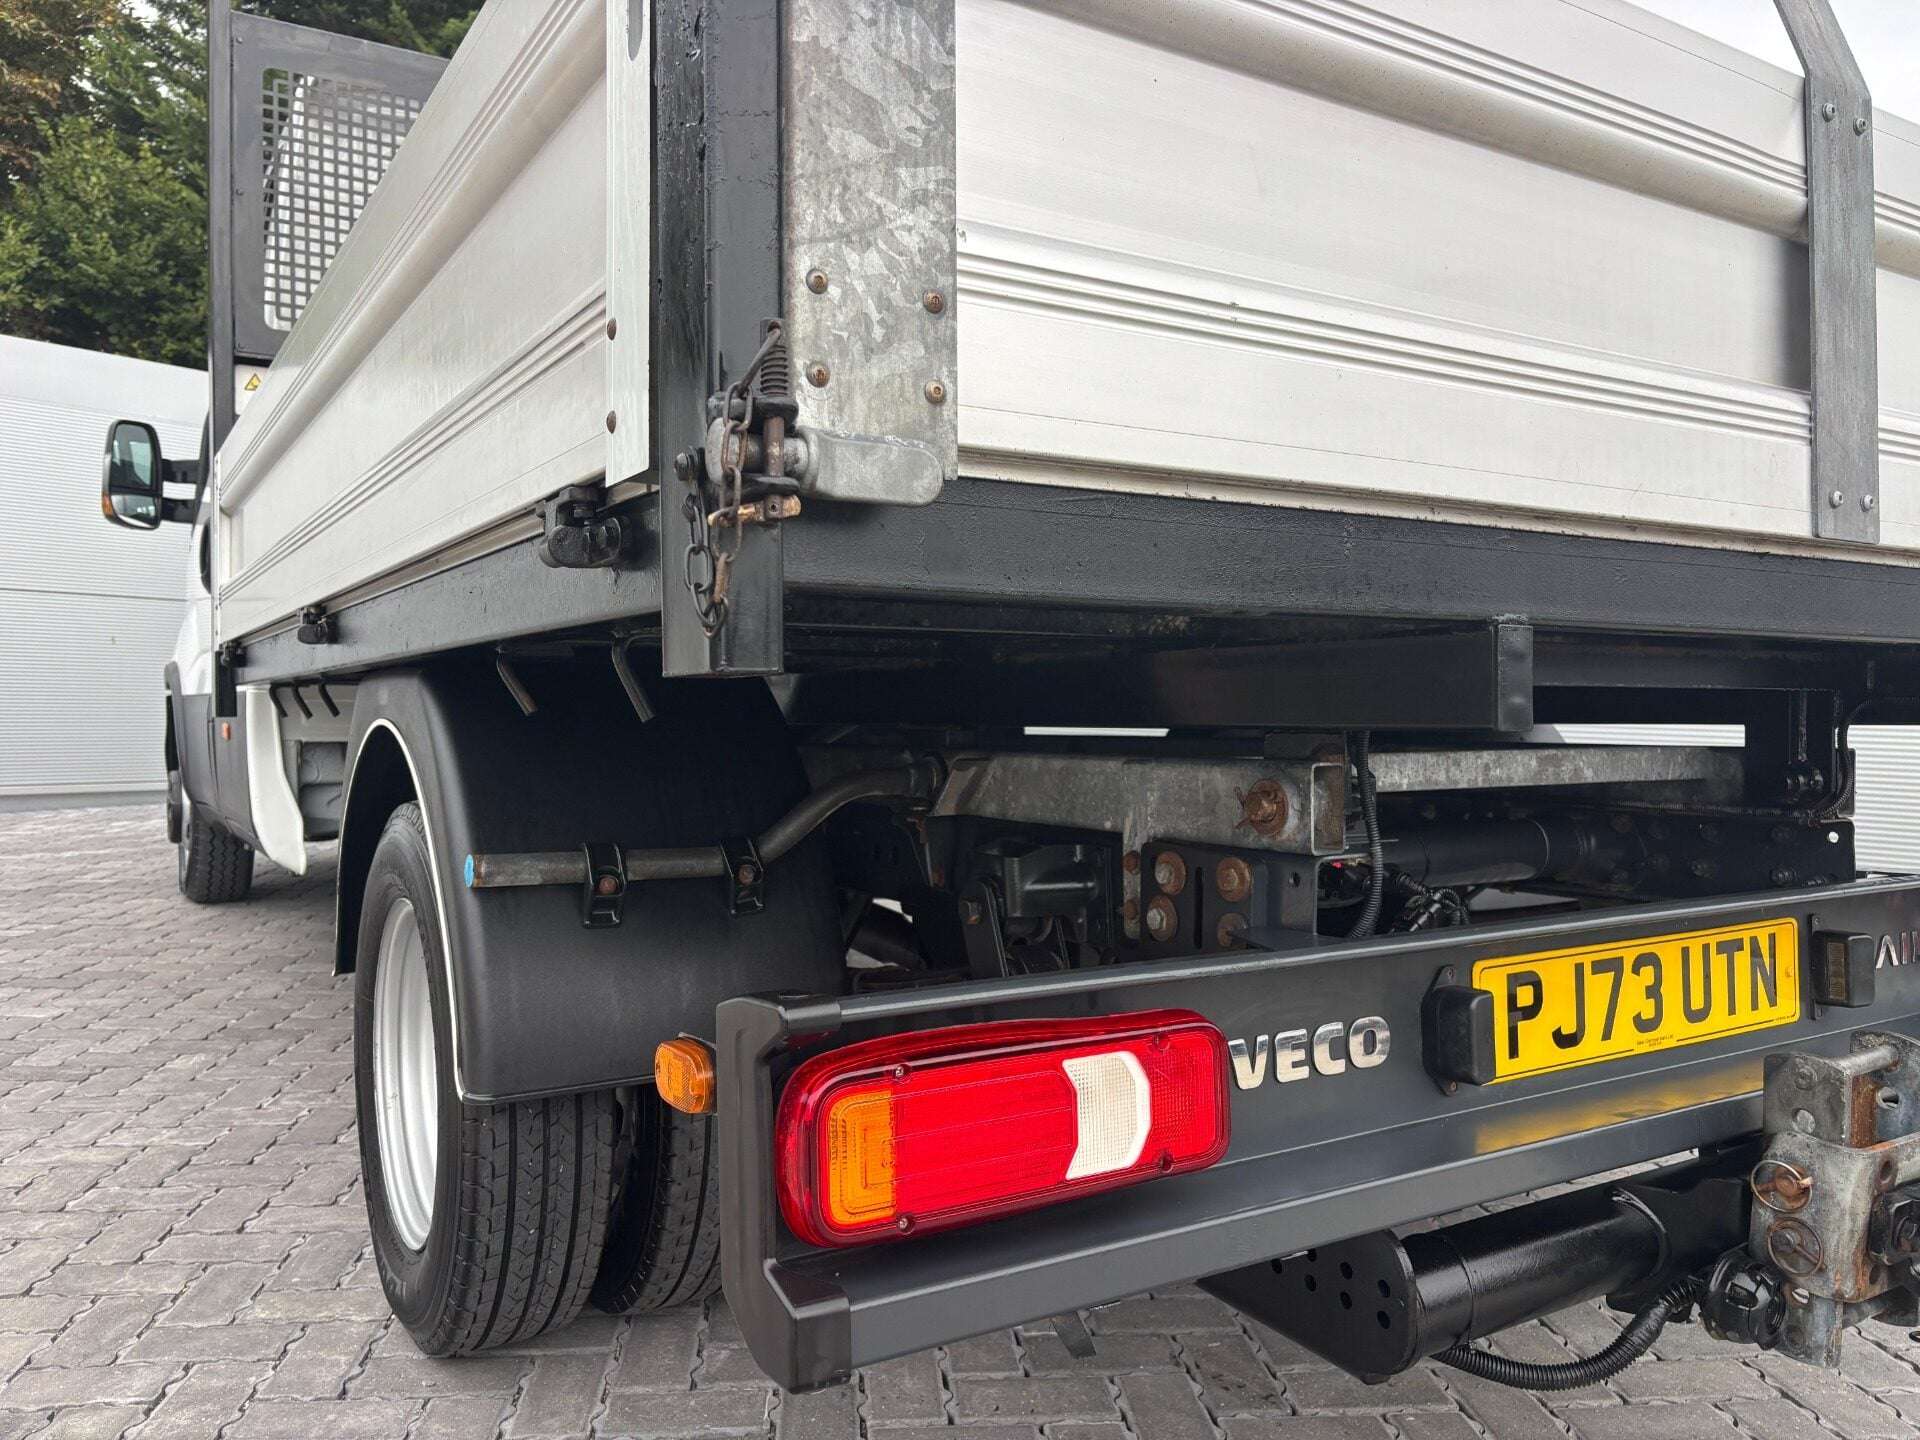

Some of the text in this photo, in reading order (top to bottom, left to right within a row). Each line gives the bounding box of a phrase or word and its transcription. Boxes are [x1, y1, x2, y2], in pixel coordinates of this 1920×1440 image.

[1506, 932, 1778, 1060] PJ73 UTN
[1227, 1015, 1391, 1090] VECO
